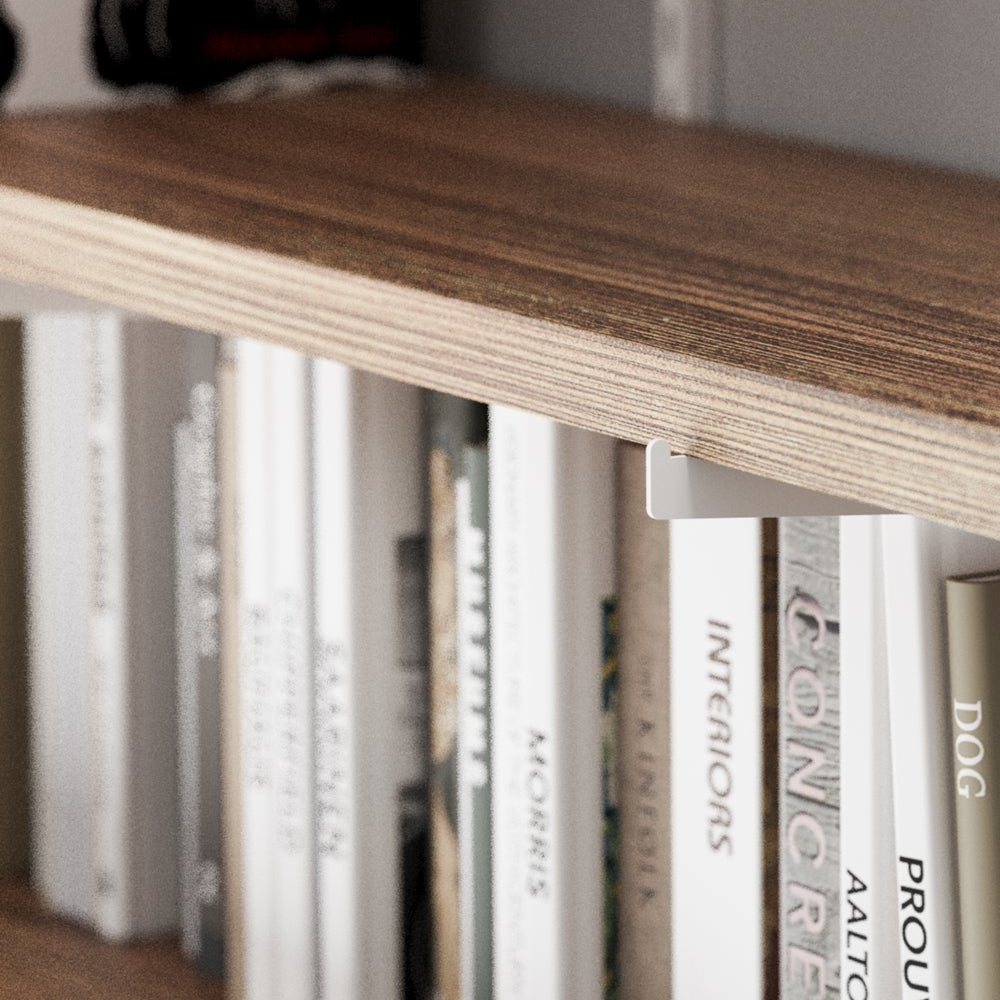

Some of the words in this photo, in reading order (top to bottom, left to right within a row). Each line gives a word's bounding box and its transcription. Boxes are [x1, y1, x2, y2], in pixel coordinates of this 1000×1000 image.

[706, 617, 735, 856] INTERIORS
[953, 698, 987, 799] DOG
[526, 727, 551, 898] MORRIS
[846, 868, 869, 1000] AALTO
[898, 855, 930, 1000] PROU
